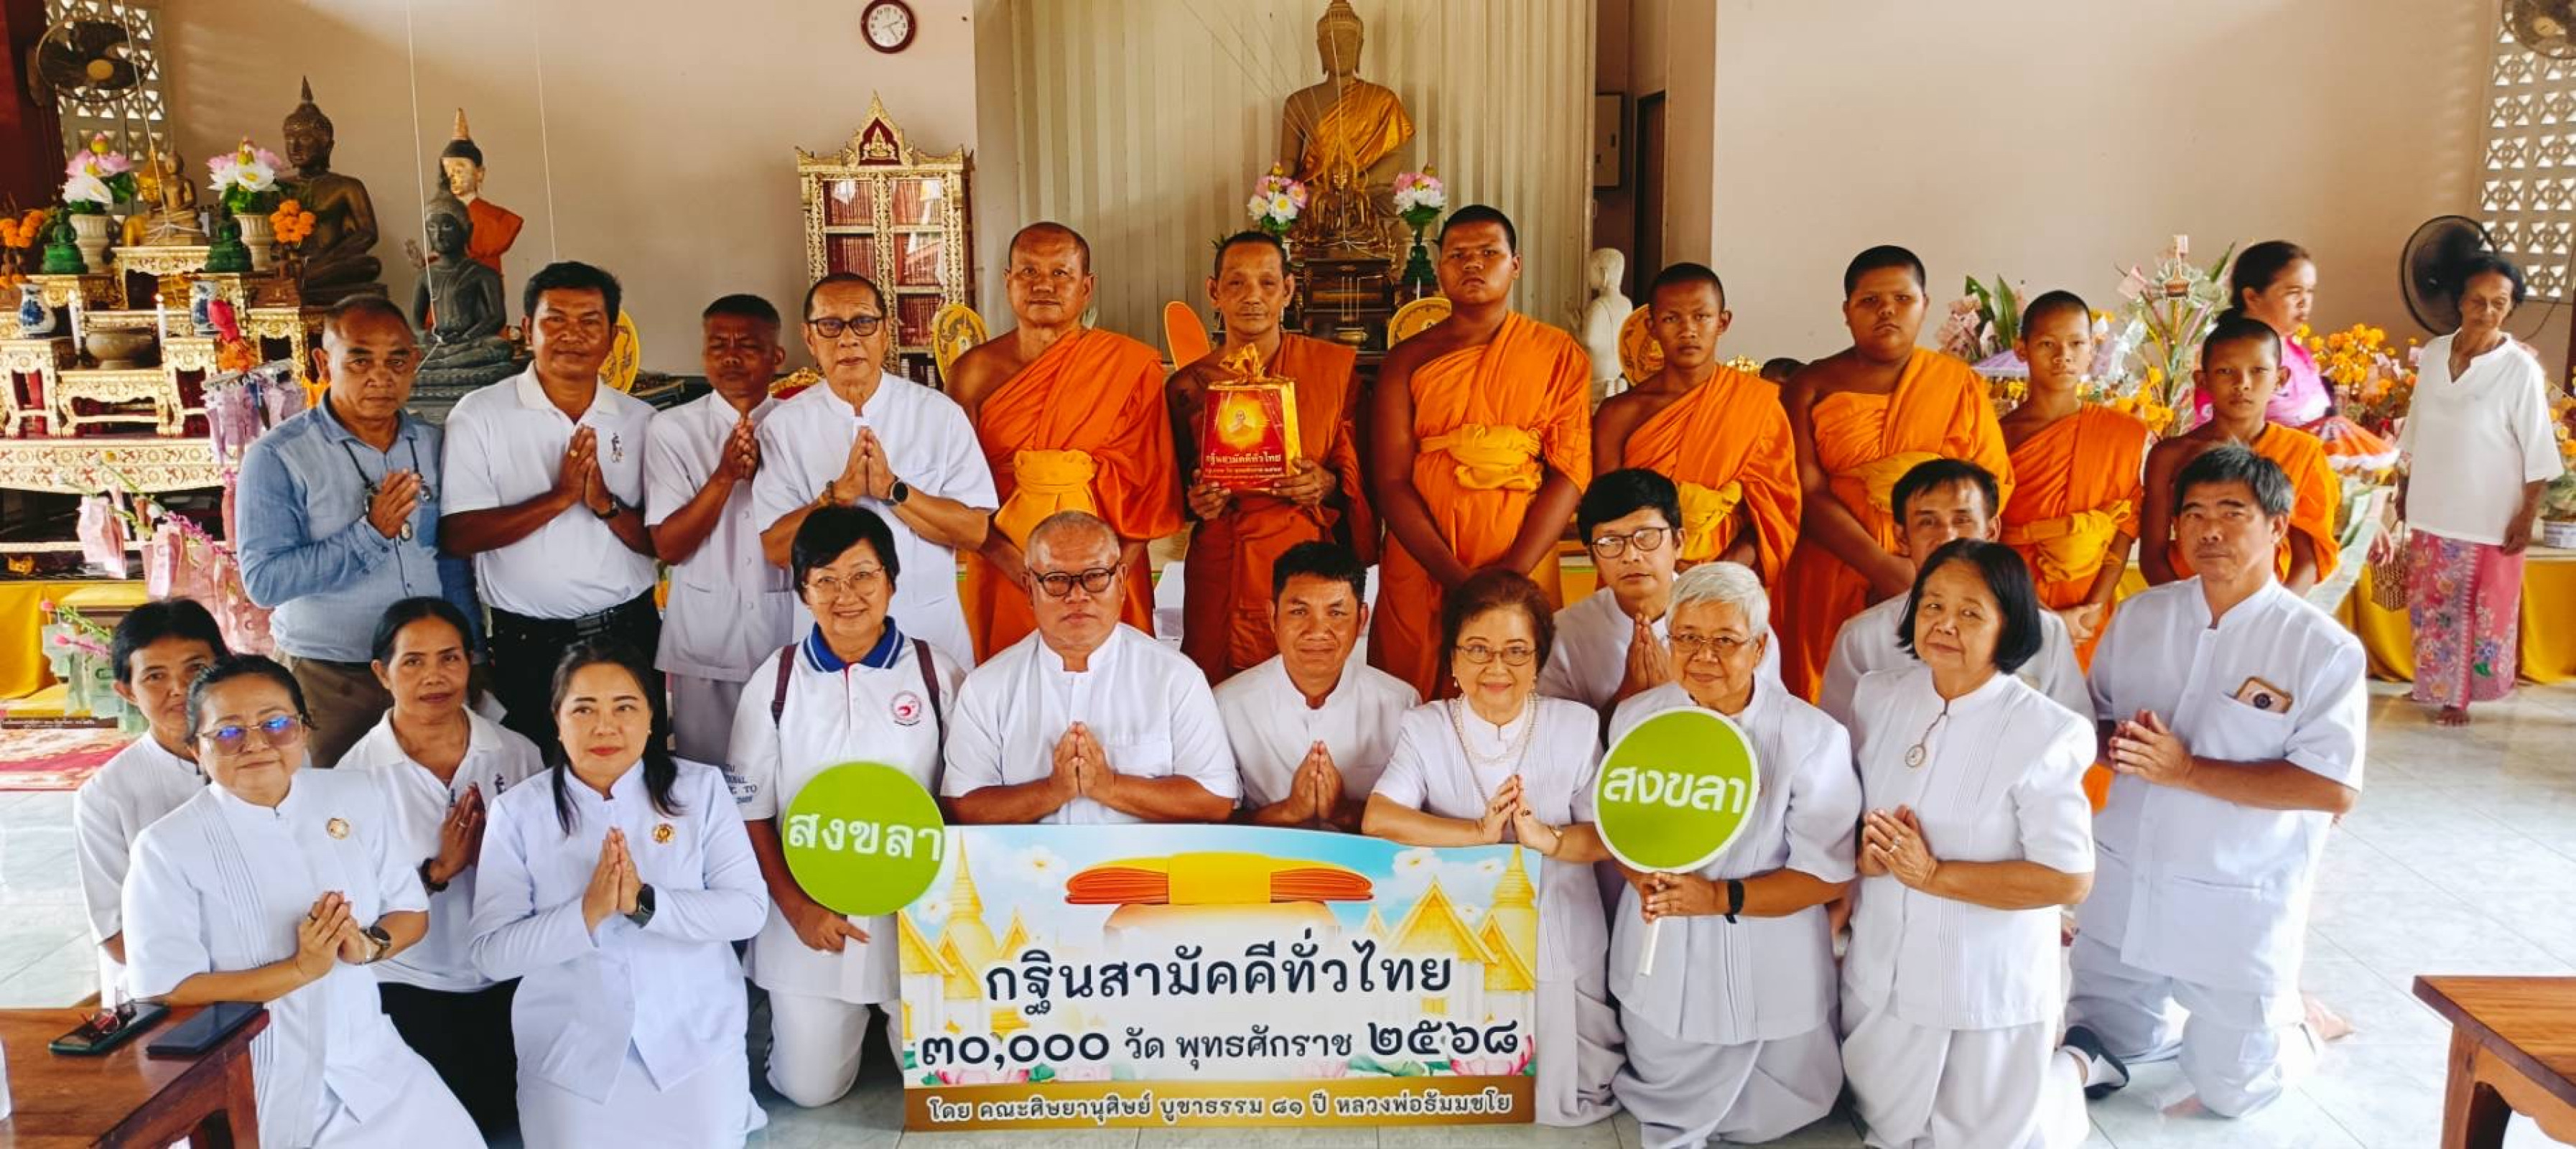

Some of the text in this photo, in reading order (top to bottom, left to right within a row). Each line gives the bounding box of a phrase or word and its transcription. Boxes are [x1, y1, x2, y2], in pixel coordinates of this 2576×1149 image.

[1603, 766, 1747, 814] สงขลา
[788, 814, 943, 862] สงขลา
[986, 928, 1451, 1015] กฐินสามัคคีทั่วไทย
[921, 1020, 1518, 1070] ๓๐,๐๐๐ วัด พุทธศักราช ๒๕๖๘
[929, 1098, 970, 1120] โดย
[980, 1092, 1150, 1123] คณะศิษยานุศิษย์
[1271, 1101, 1303, 1115] ๘๑
[1311, 1091, 1327, 1114] ปี
